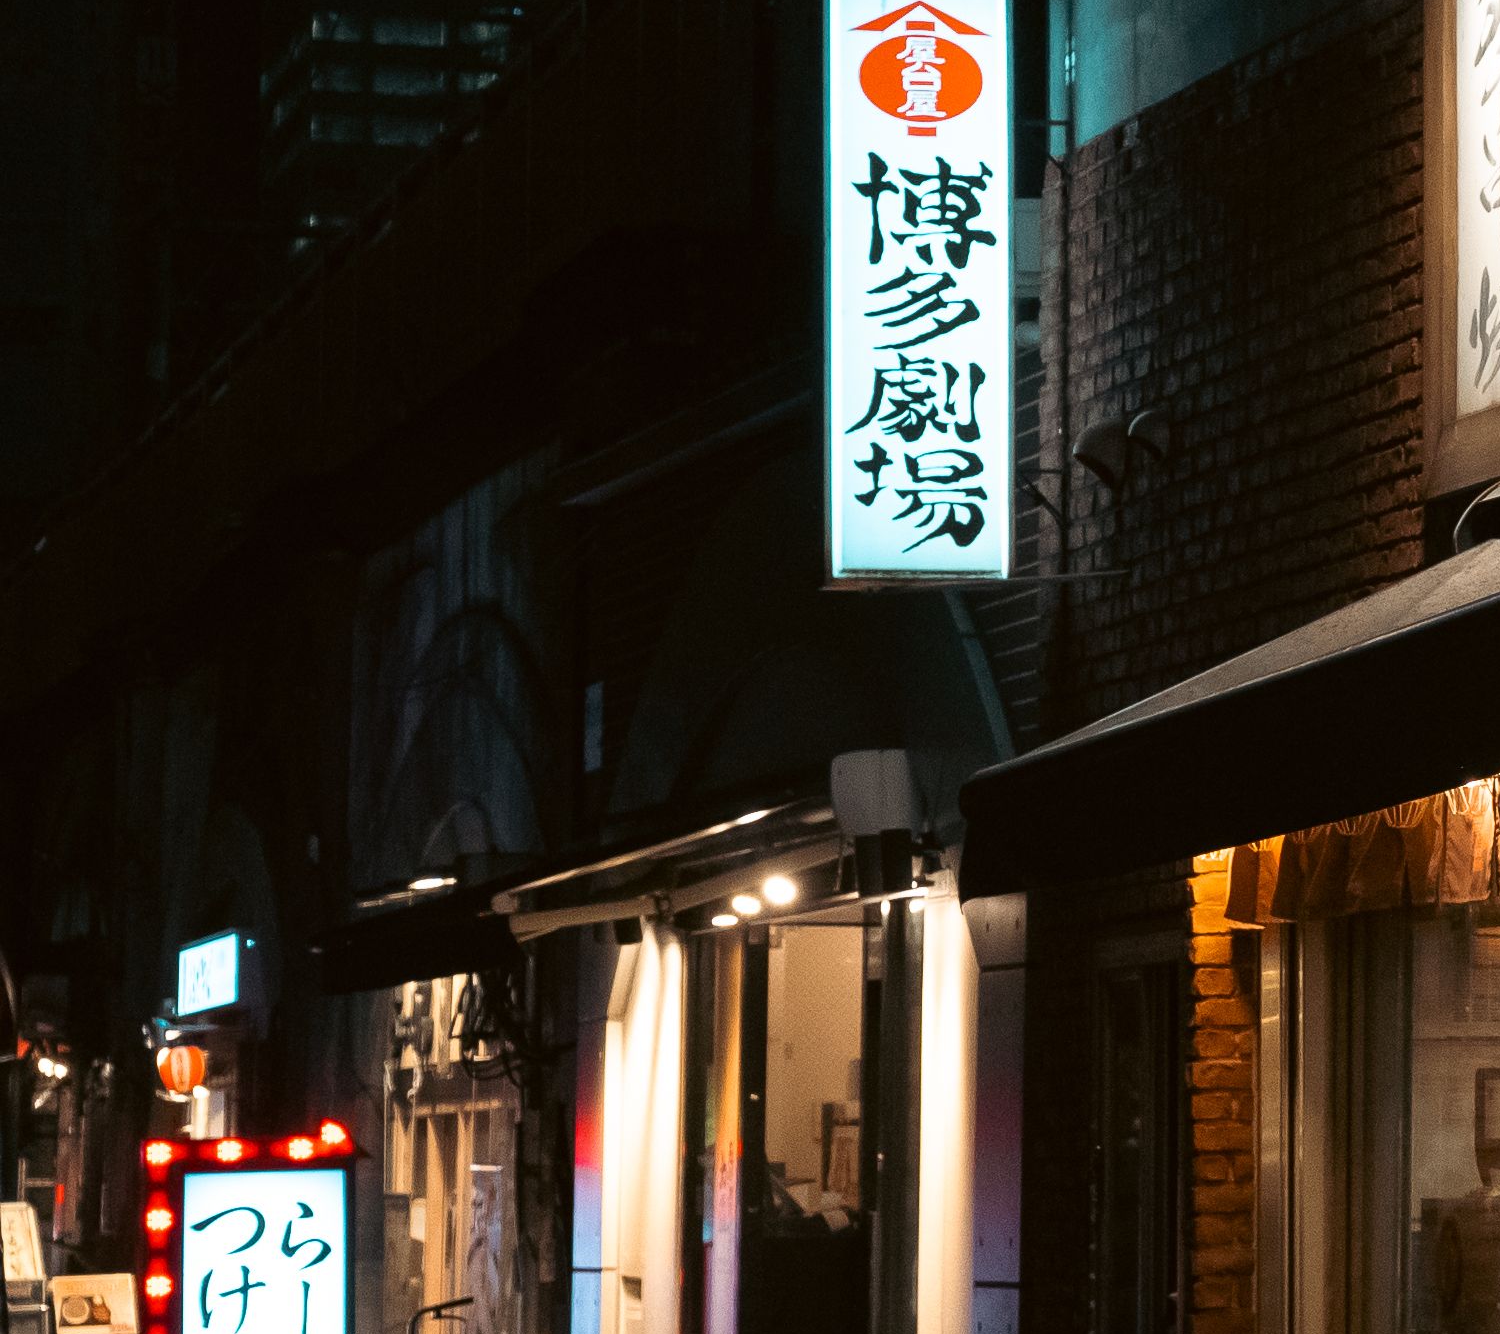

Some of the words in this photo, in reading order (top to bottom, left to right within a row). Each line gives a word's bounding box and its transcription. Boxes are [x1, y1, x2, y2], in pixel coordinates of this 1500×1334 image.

[896, 35, 947, 119] 屋台屋
[845, 151, 996, 554] 博多劇場
